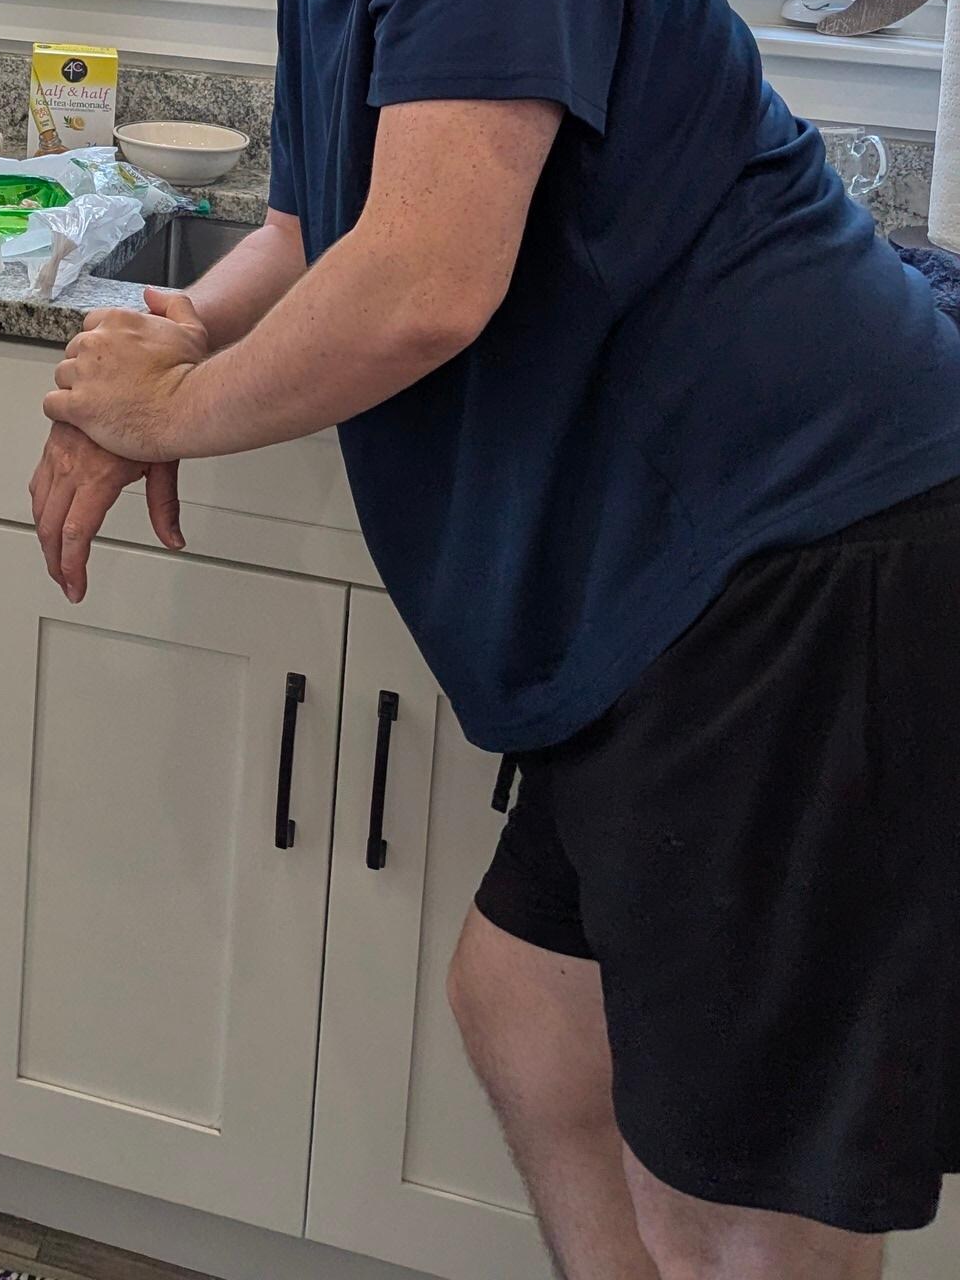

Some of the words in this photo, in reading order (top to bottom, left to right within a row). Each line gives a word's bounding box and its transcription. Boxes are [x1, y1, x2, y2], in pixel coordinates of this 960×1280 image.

[36, 85, 65, 100] half
[67, 87, 78, 97] &
[81, 87, 111, 103] half
